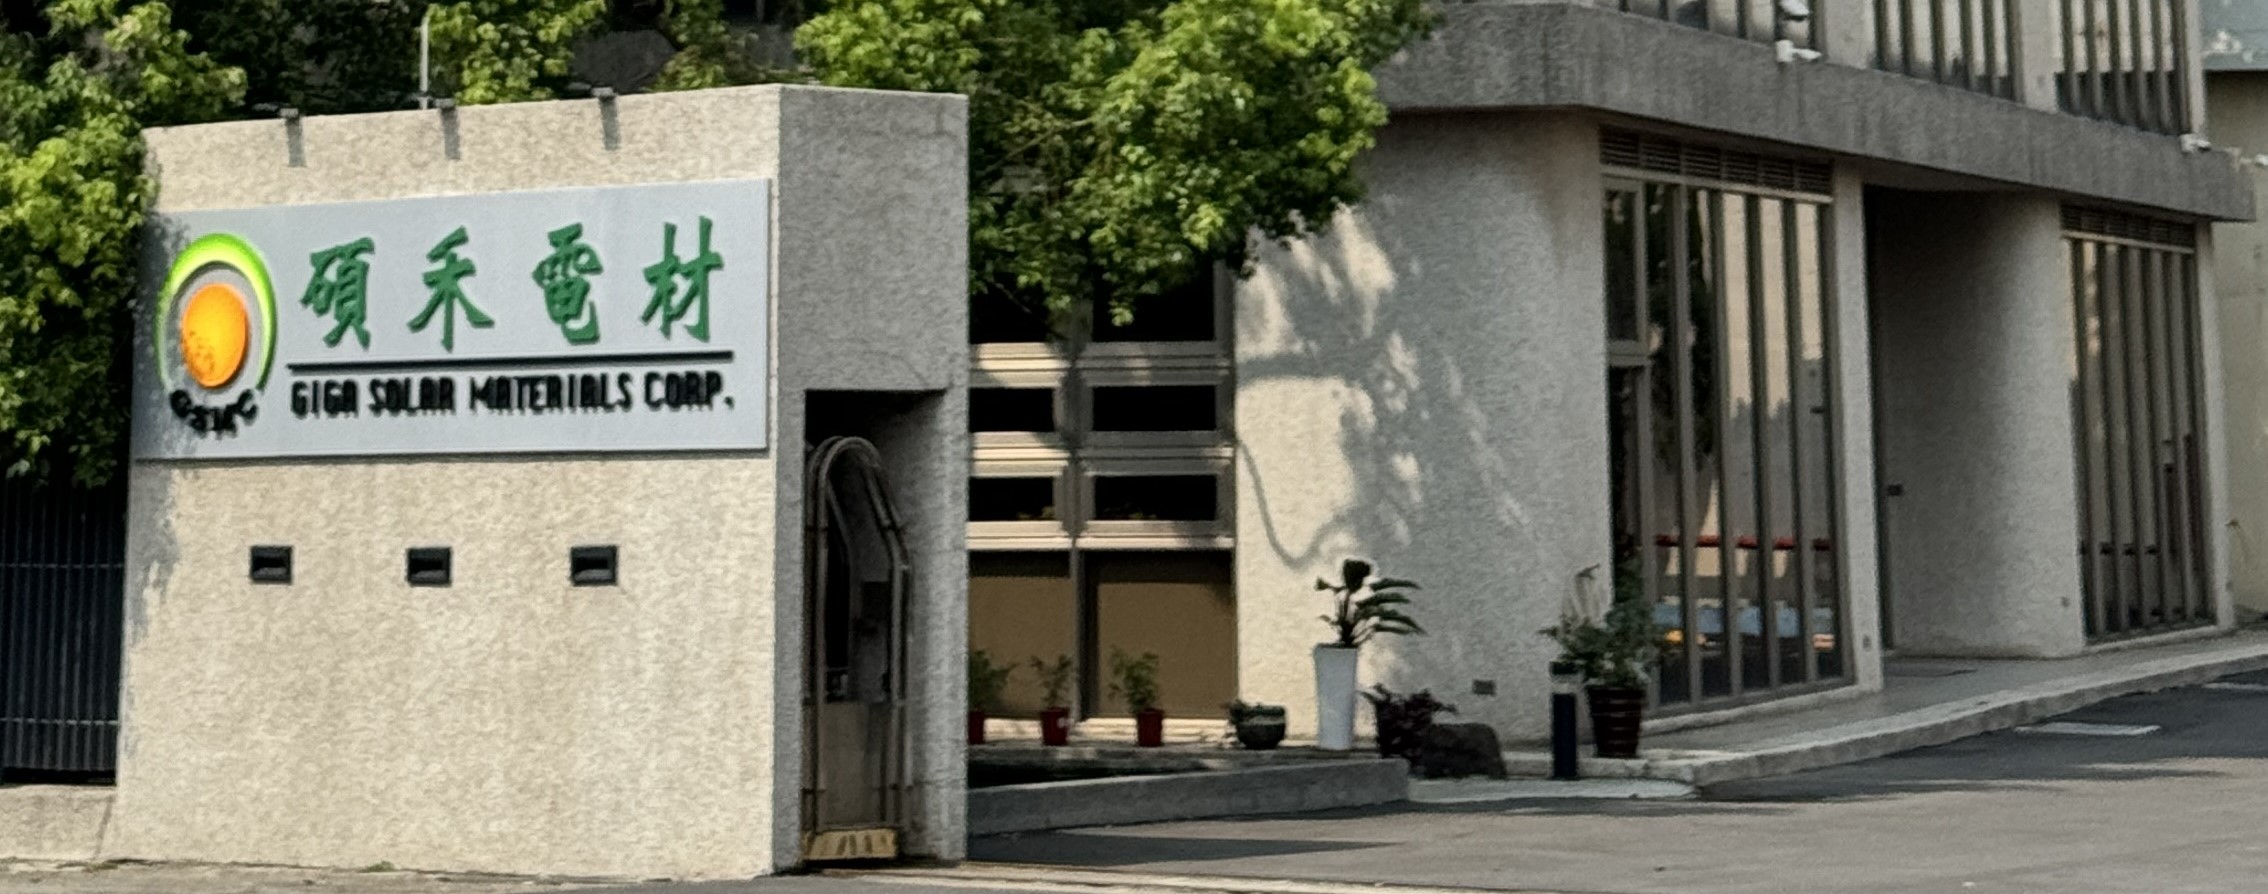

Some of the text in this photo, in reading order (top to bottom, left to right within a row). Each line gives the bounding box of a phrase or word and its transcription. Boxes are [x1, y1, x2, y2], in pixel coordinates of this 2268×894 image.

[301, 215, 724, 351] 碩禾電材
[291, 371, 735, 417] GIGA SOLAR MATERIALS CORP.
